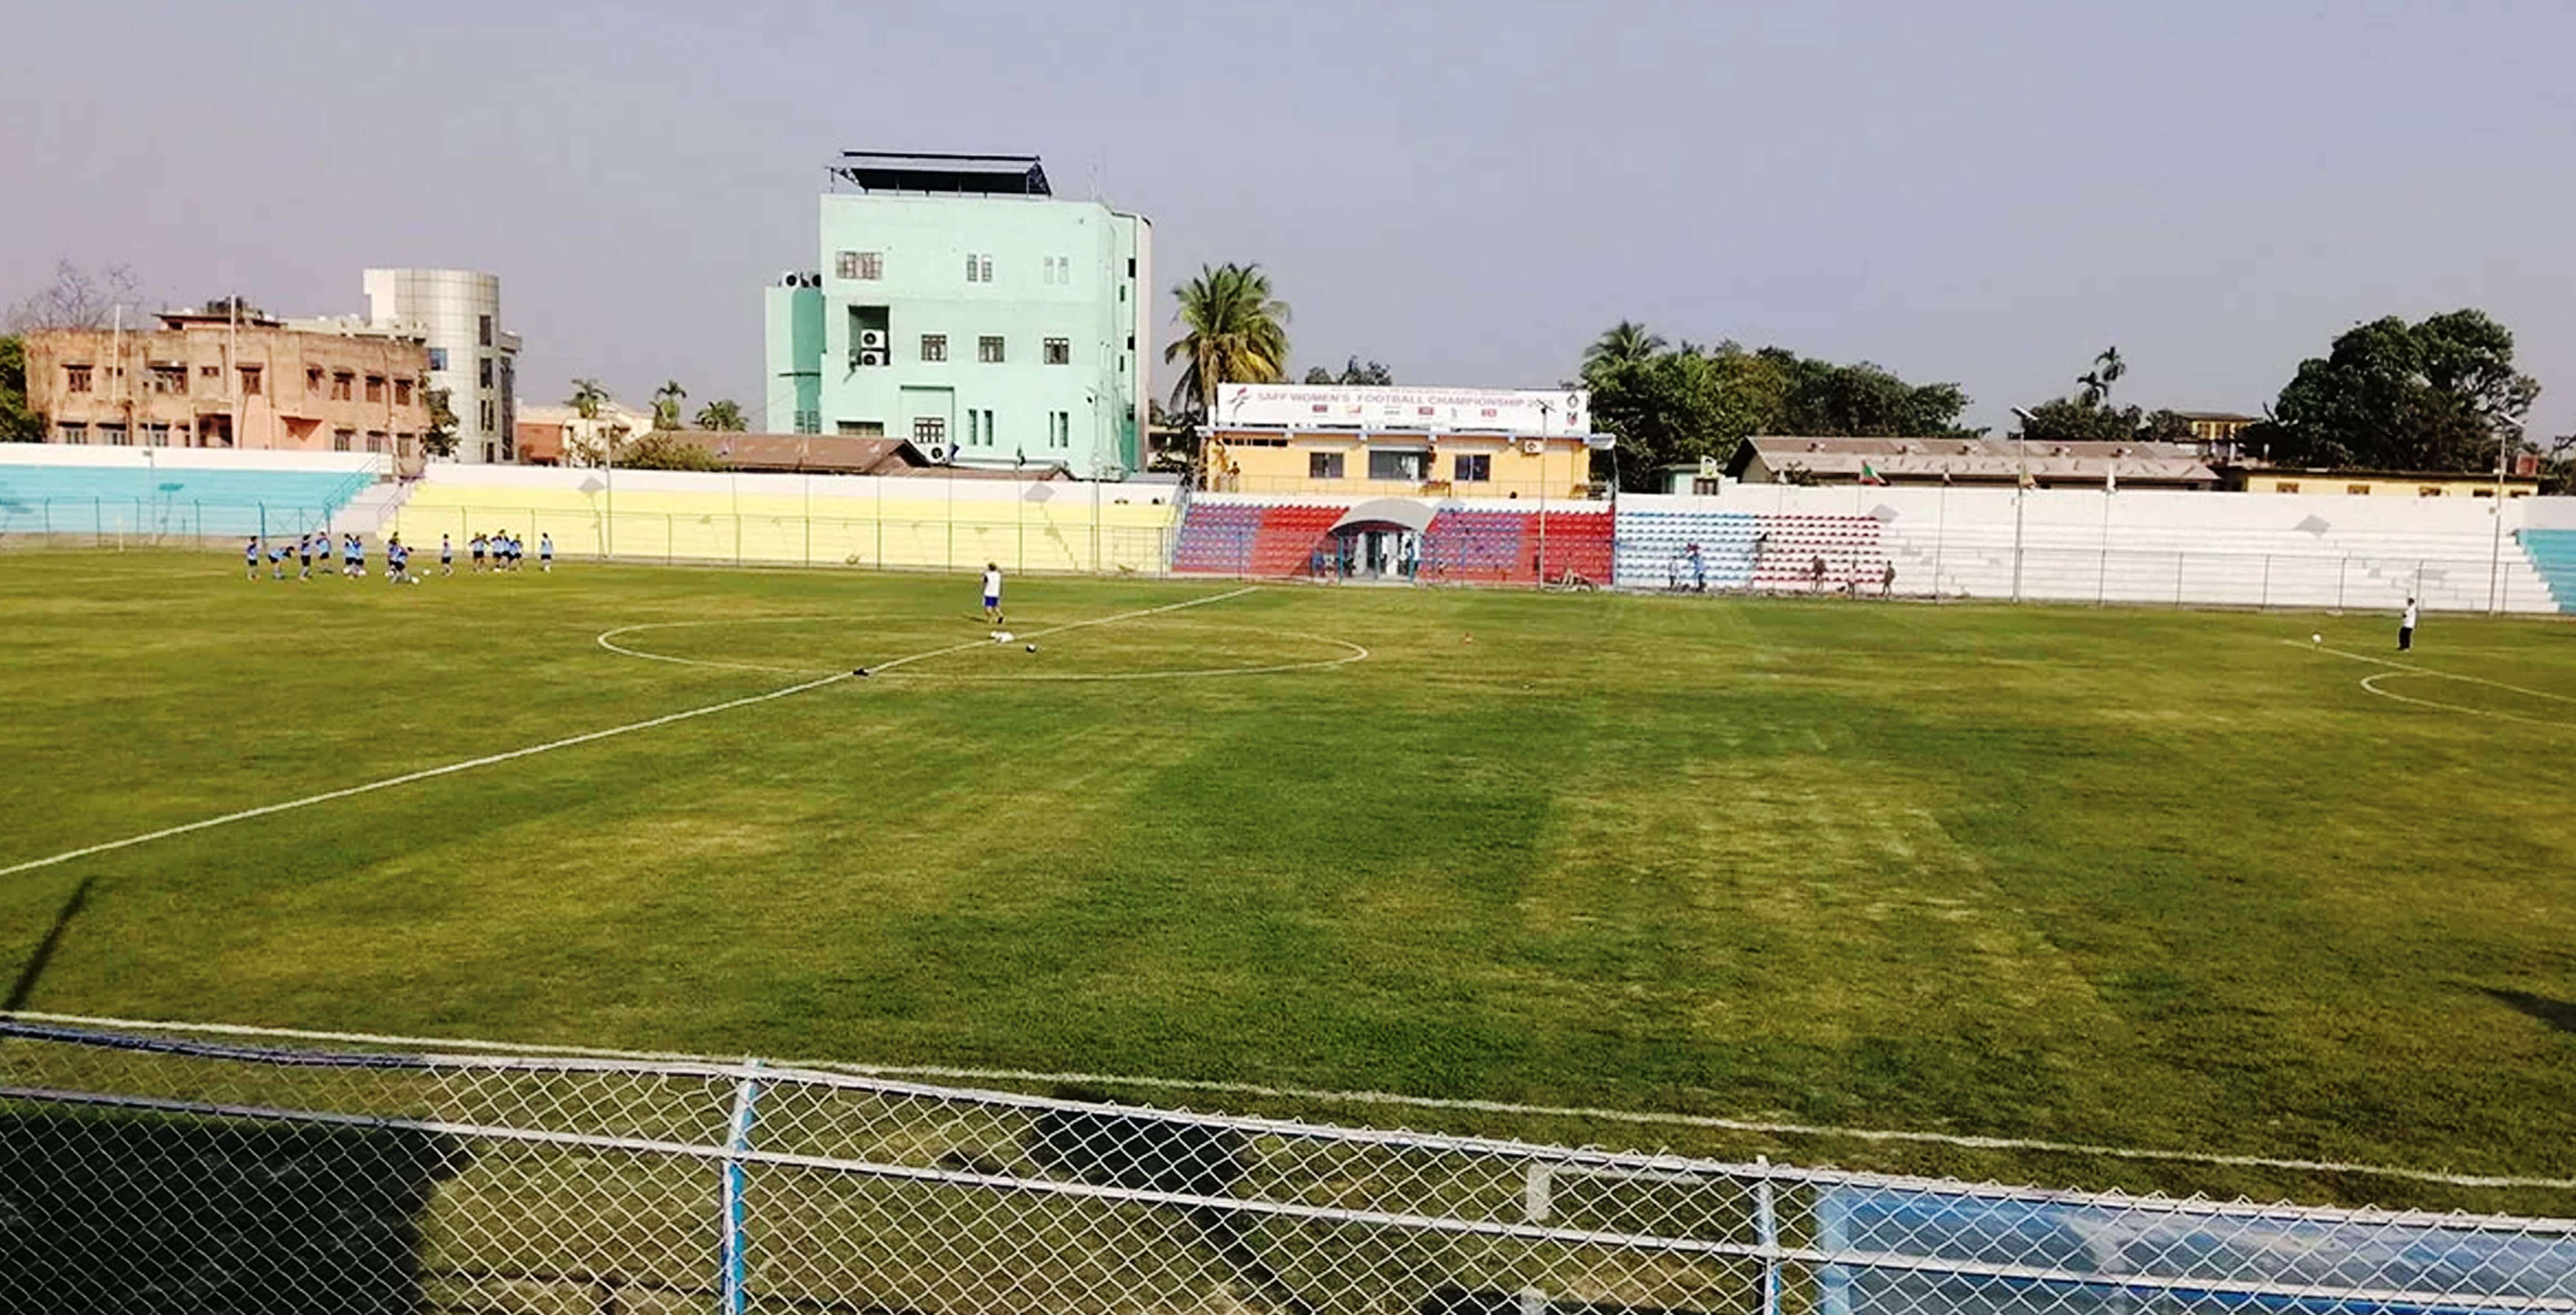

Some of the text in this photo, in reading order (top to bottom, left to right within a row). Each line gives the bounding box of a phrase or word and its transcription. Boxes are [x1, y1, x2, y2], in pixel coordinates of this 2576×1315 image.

[1257, 392, 1287, 401] SAFF
[1290, 393, 1350, 402] WOMEN'S
[1357, 393, 1423, 404] FOOTBALL
[1428, 395, 1524, 407] CHAMPIONSHIP
